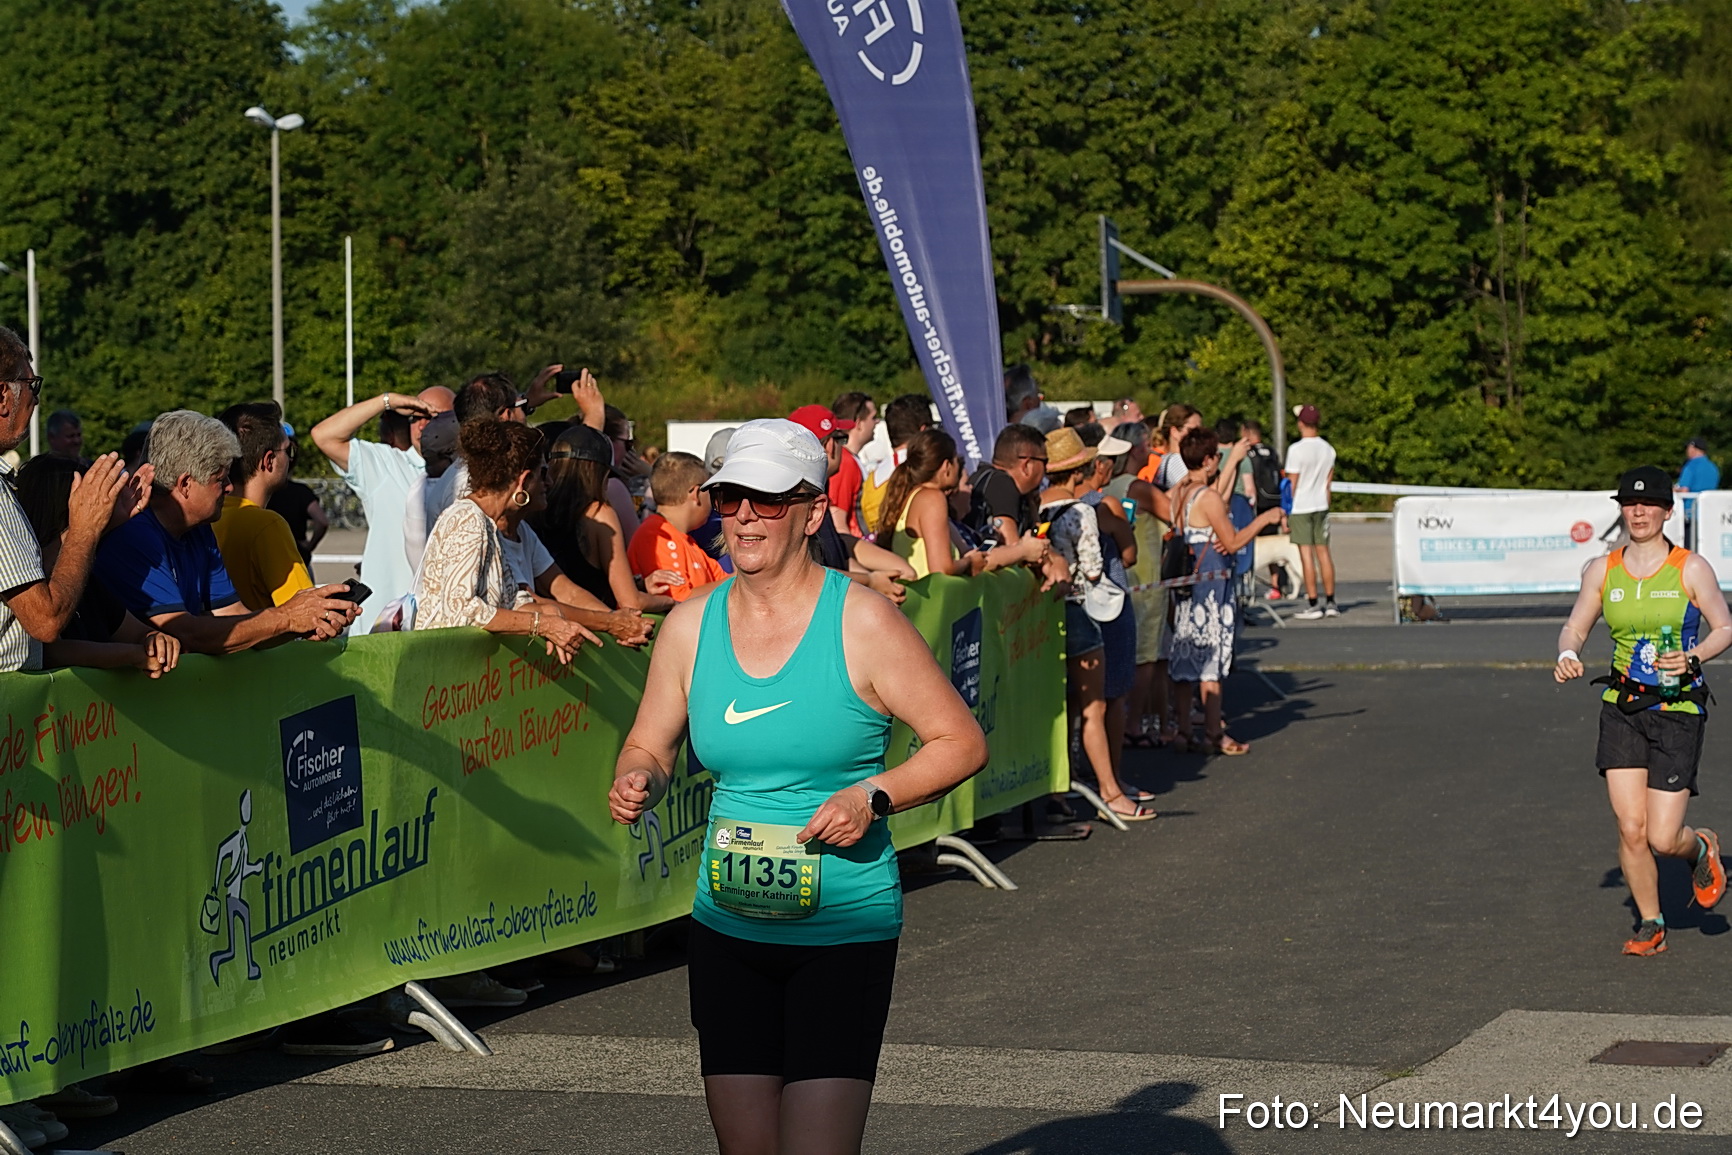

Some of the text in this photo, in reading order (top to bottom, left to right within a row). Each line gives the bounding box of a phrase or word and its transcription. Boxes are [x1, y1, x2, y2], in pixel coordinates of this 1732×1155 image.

[1418, 517, 1454, 530] NOW
[422, 656, 504, 730] Gesunde
[34, 702, 118, 764] Firmen
[459, 682, 589, 777] laufen länger!
[297, 744, 346, 781] Fischer
[302, 767, 342, 792] AUTOMOBILE
[0, 742, 142, 853] fen länger!
[262, 786, 438, 933] firmenlauf
[711, 859, 721, 892] RUN
[722, 852, 798, 889] 1135
[720, 883, 799, 901] Emminger Kathrin
[800, 864, 813, 907] 2022
[268, 907, 341, 967] neumarkt
[384, 880, 598, 966] www.firmenlauf-oberpfalz.de
